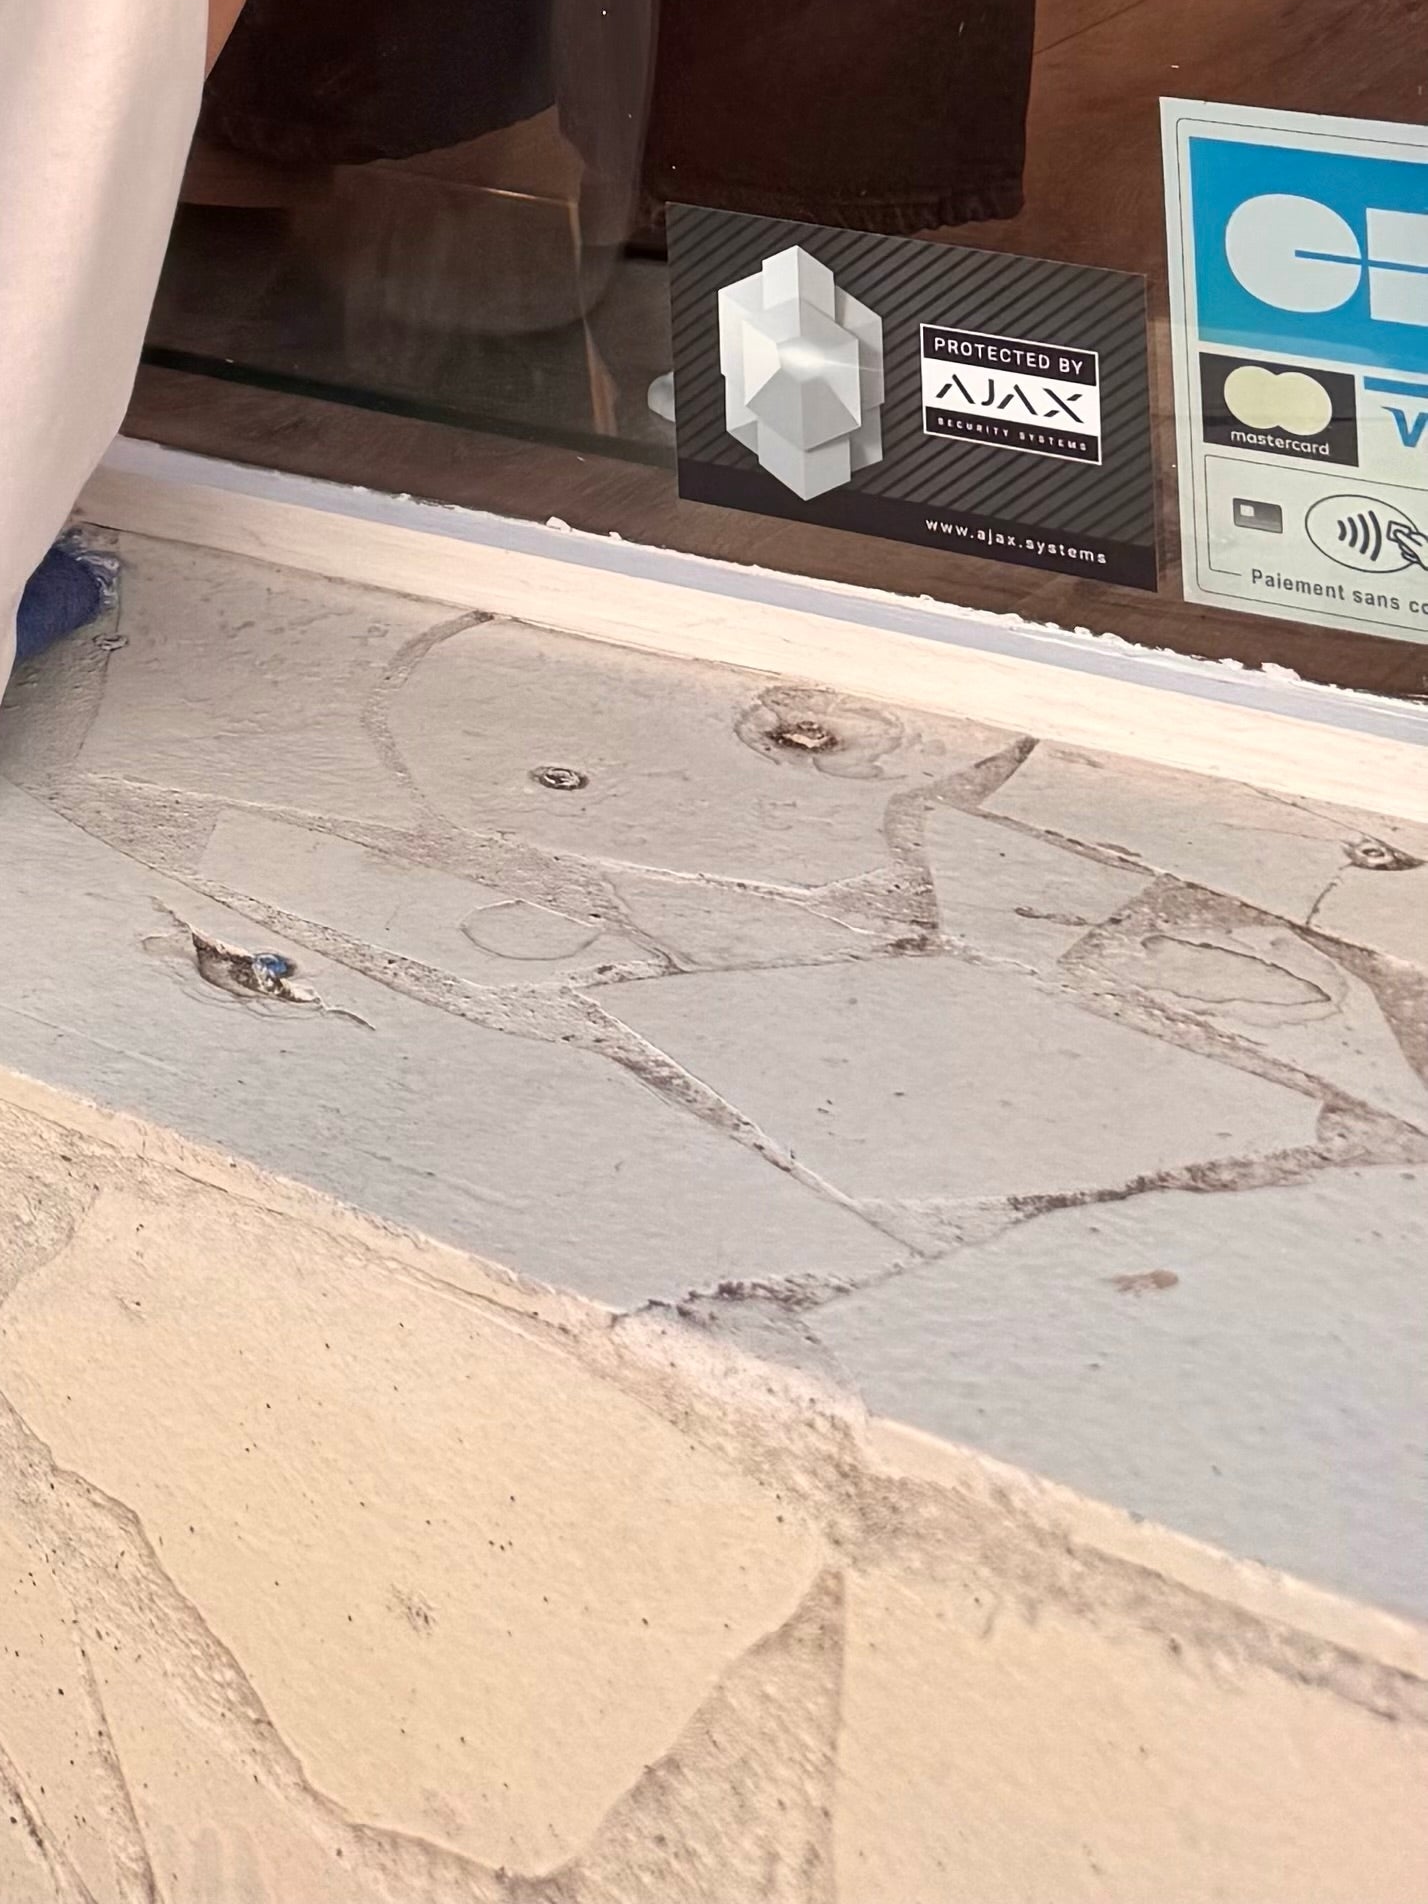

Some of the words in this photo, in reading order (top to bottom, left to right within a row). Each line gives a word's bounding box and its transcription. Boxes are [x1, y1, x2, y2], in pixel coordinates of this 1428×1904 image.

[934, 337, 1050, 369] PROTECTED
[1059, 357, 1084, 375] BY
[935, 374, 1085, 424] AJAX
[937, 417, 1009, 437] SECURITY
[1019, 431, 1087, 451] SYSTEMS
[1230, 430, 1330, 456] mastercard
[925, 519, 1107, 564] www.ajax.systems
[1251, 568, 1345, 601] Paiement
[1352, 588, 1400, 611] sans
